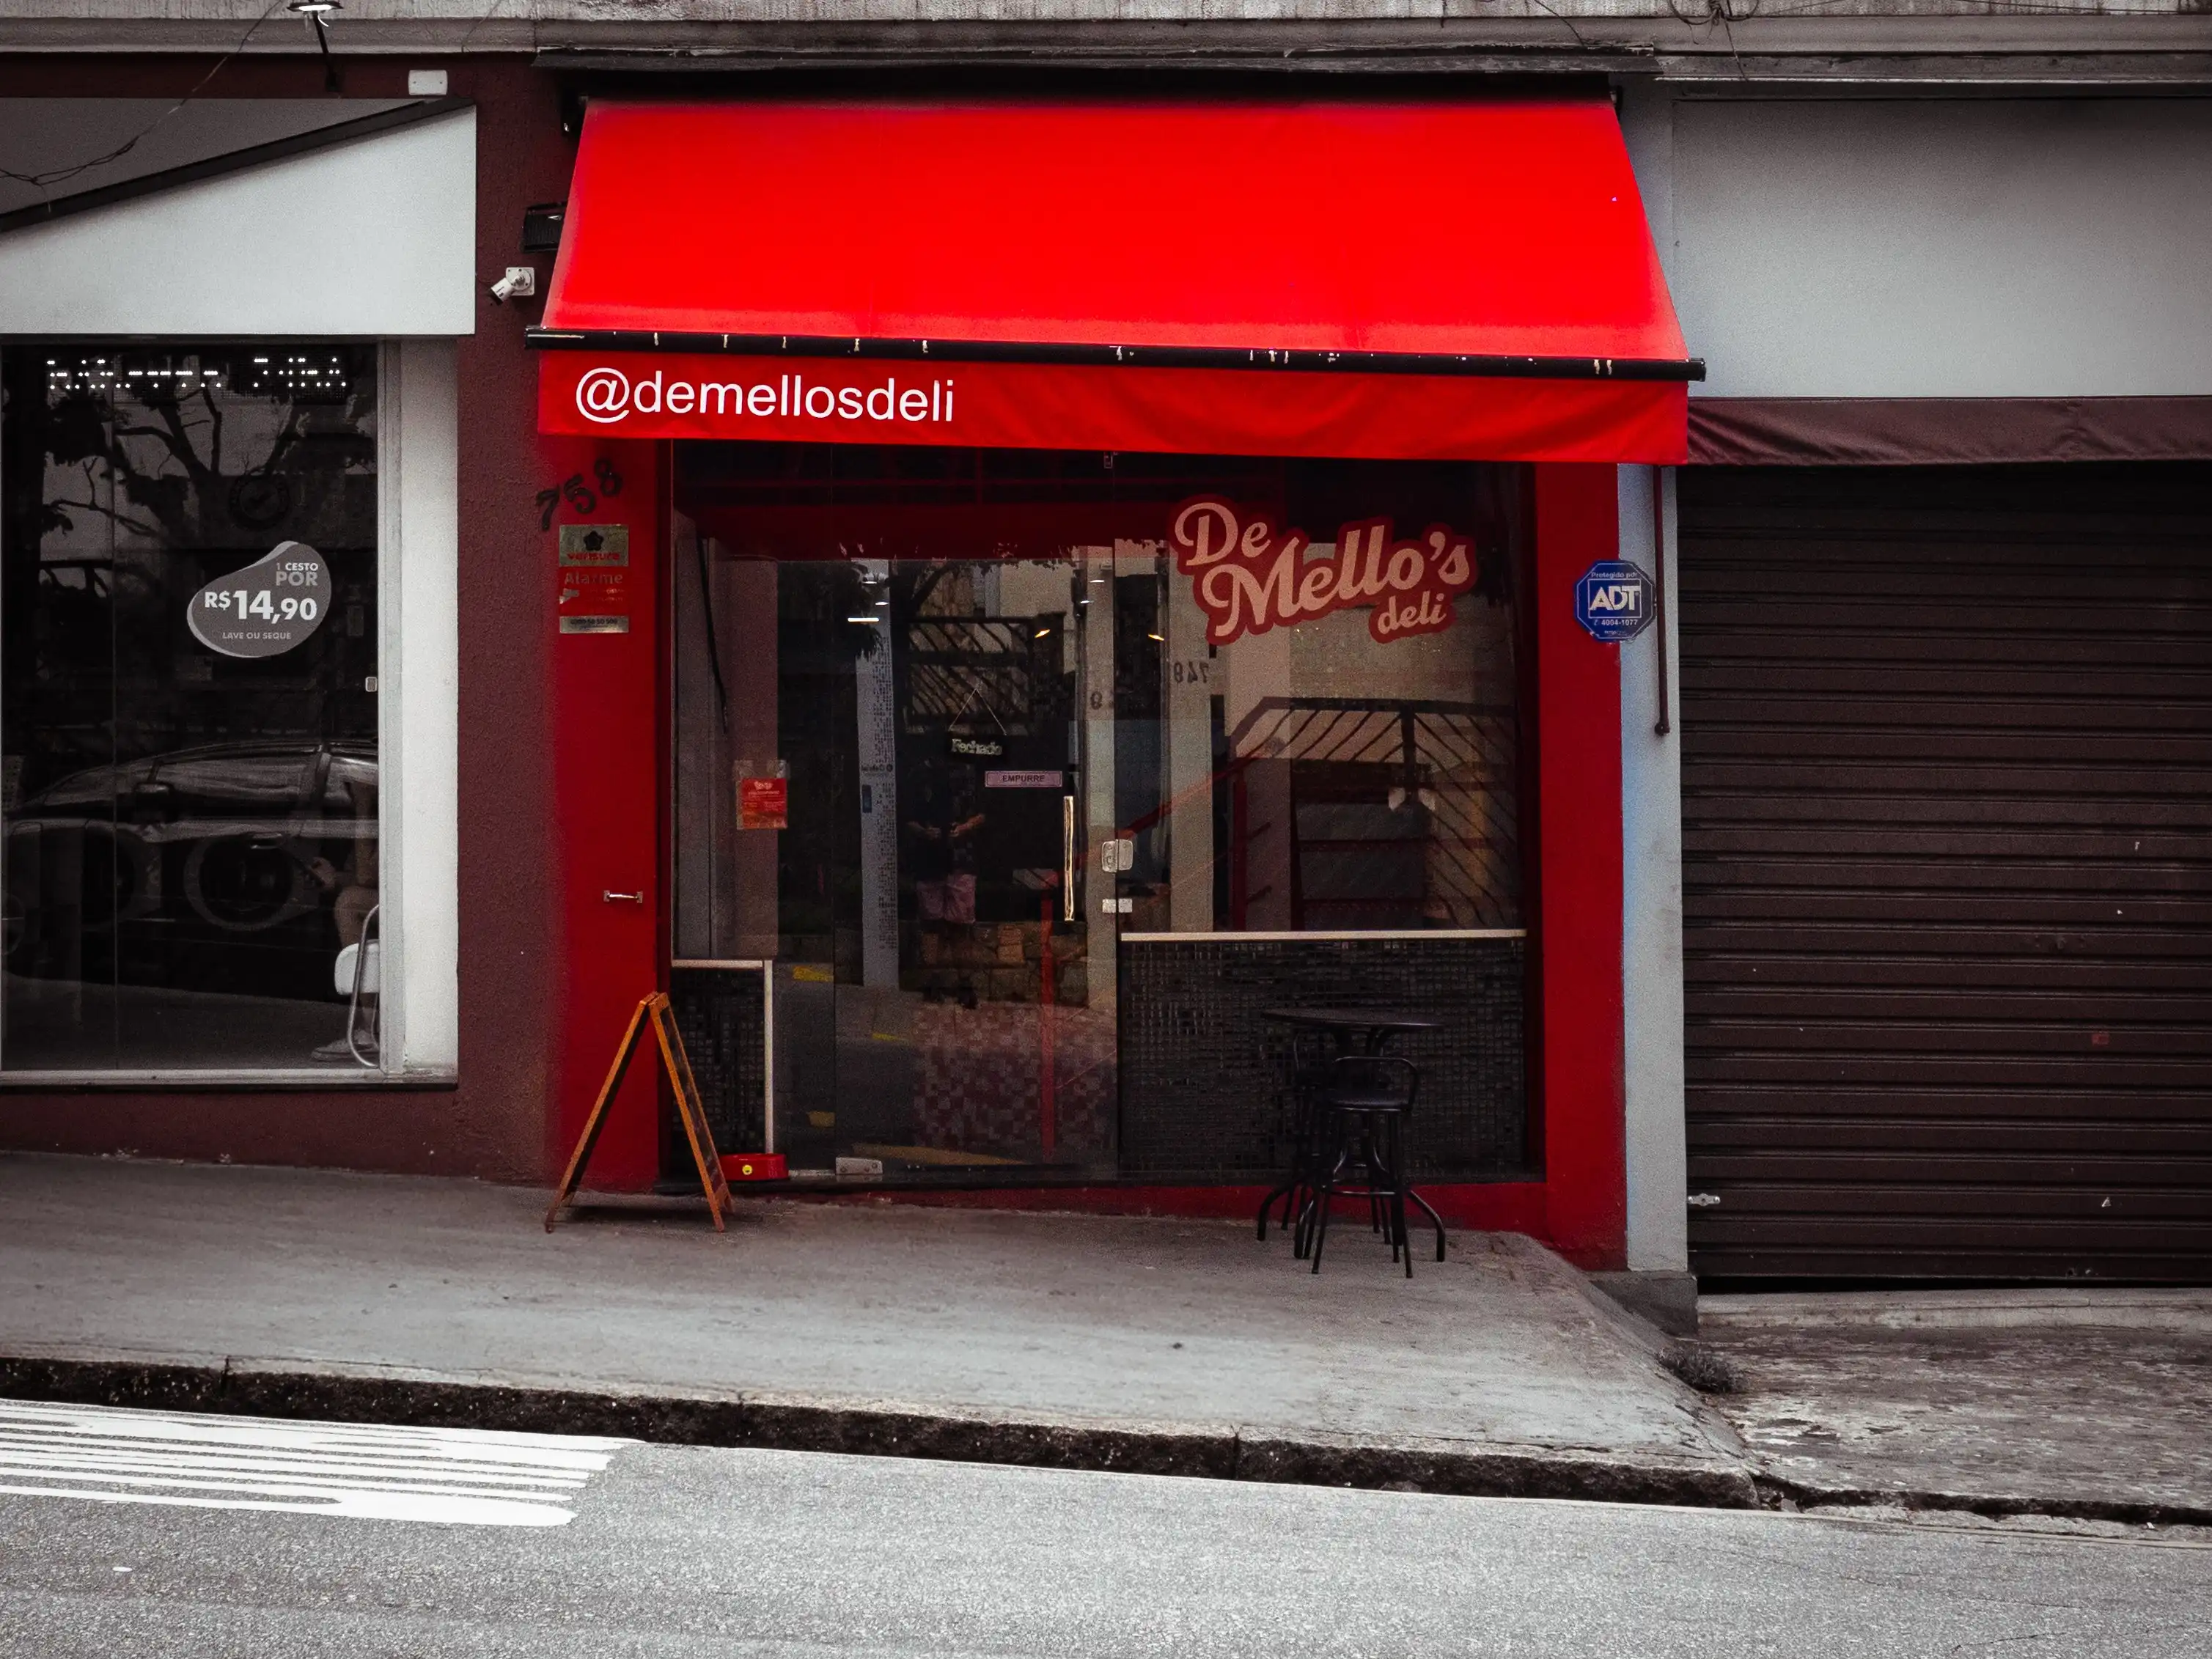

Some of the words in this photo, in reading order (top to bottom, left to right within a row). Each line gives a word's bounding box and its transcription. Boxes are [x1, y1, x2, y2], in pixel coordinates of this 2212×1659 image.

[576, 367, 953, 423] @demellosdeli
[535, 456, 623, 531] 758
[1175, 502, 1272, 566] De
[276, 571, 318, 586] POR
[284, 562, 319, 571] CESTO
[1202, 524, 1470, 637] Mello's
[1377, 591, 1447, 635] deli
[1589, 586, 1641, 611] ADT
[262, 632, 291, 640] SEQUE
[1002, 774, 1046, 783] EMPURRE
